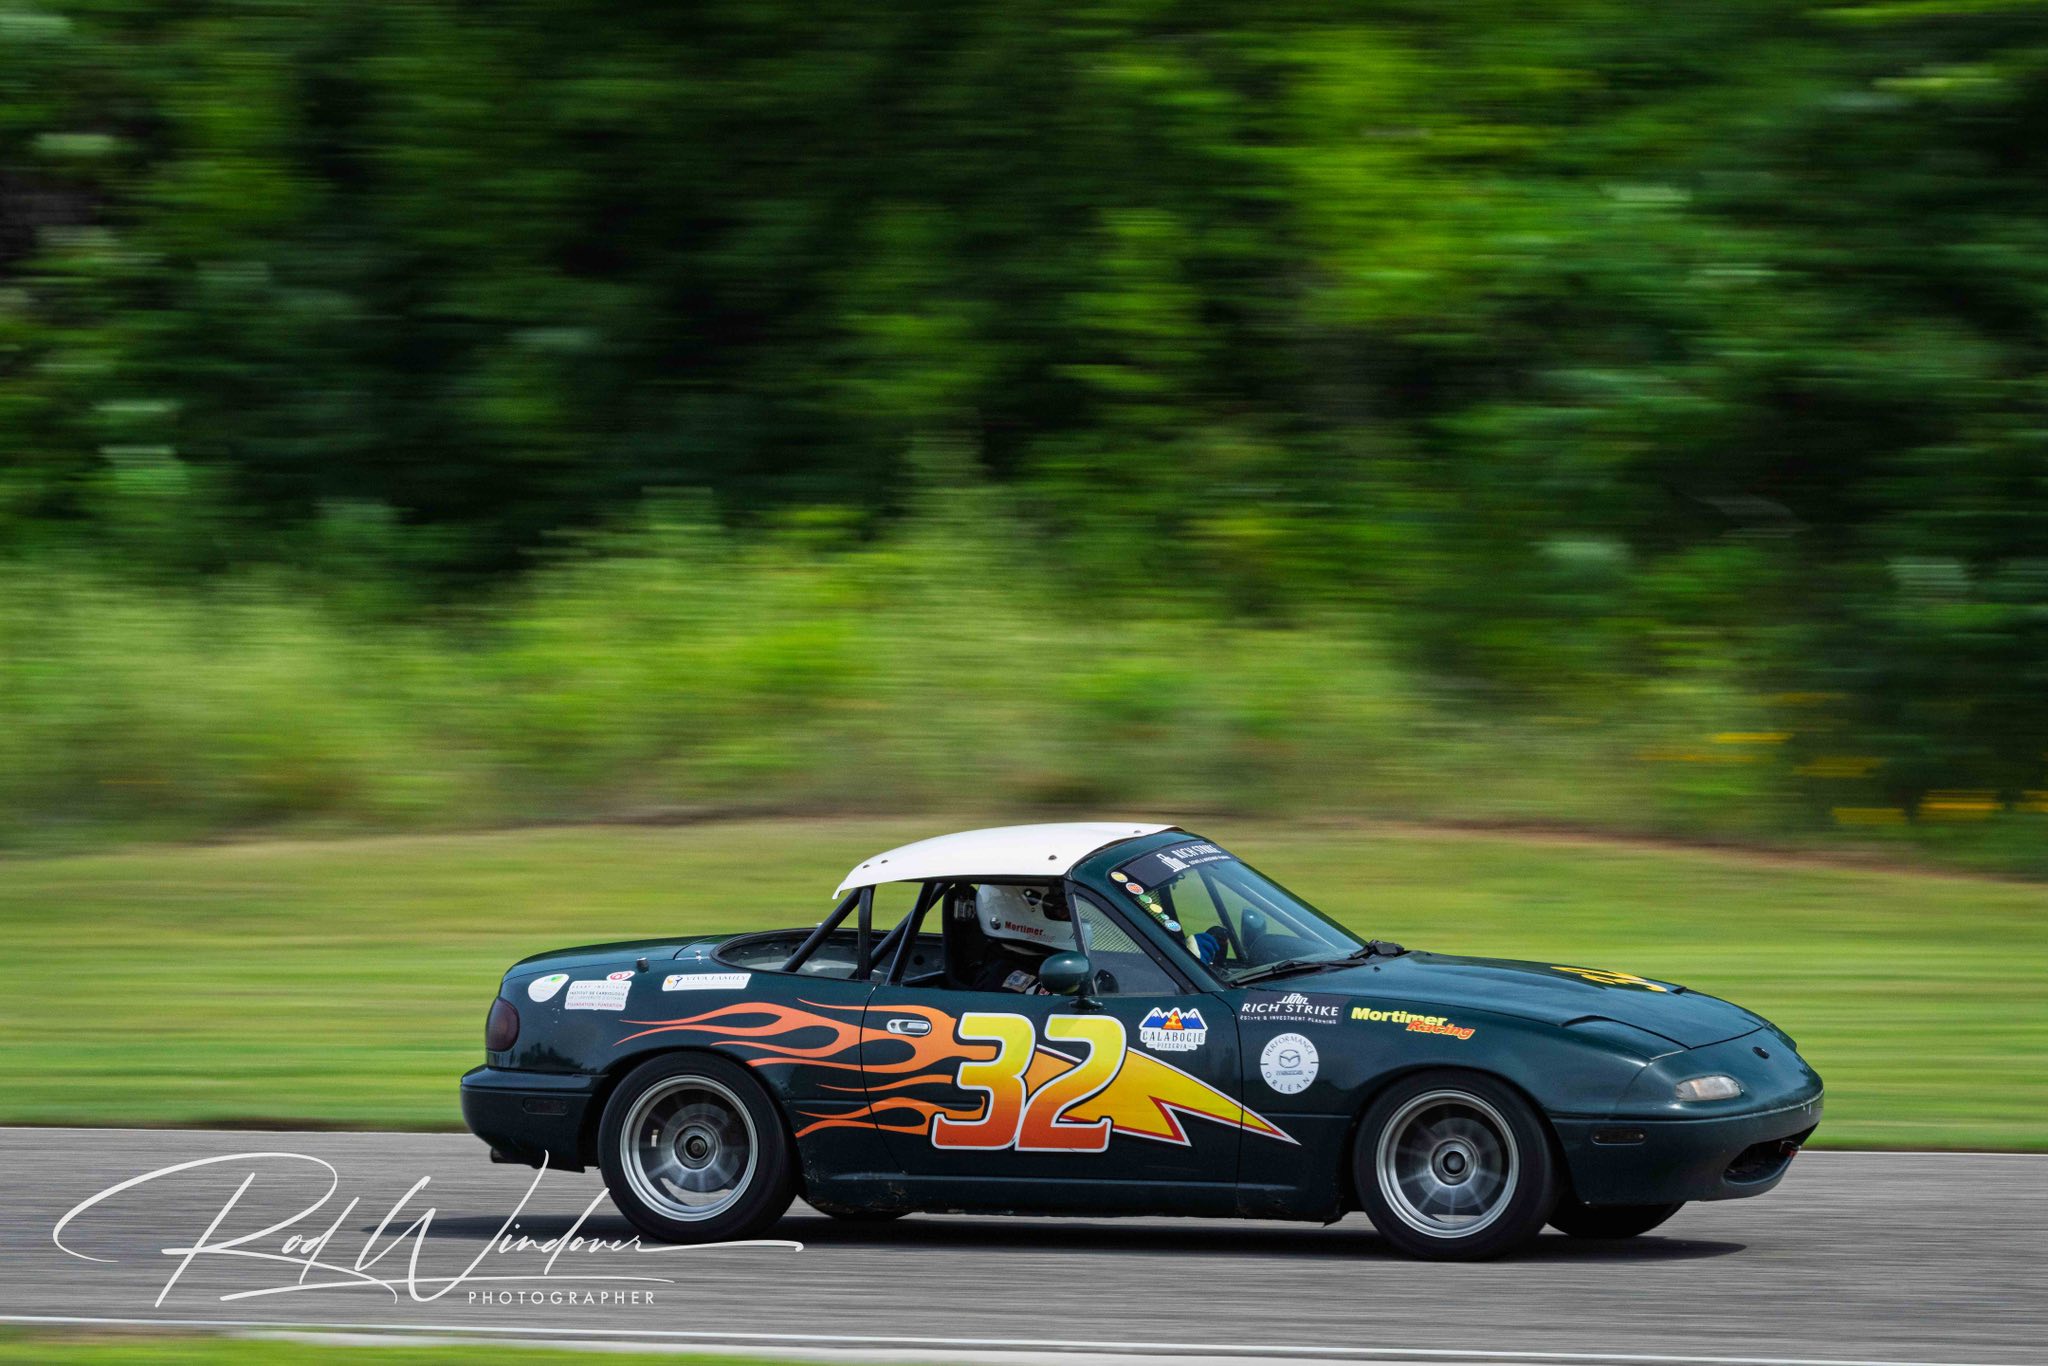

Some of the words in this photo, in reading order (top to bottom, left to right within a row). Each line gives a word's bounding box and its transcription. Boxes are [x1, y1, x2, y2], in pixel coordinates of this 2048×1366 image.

[1004, 921, 1044, 936] Mortimer
[1241, 1003, 1280, 1013] RICH
[1285, 1004, 1340, 1017] STRIKE
[1351, 1007, 1448, 1026] Mortimer
[1307, 1017, 1337, 1025] PLANNING
[1406, 1019, 1476, 1040] Racing
[1142, 1030, 1204, 1043] CALABOGIE
[1265, 1035, 1315, 1057] PERFORMANCE
[931, 1011, 1127, 1153] 32
